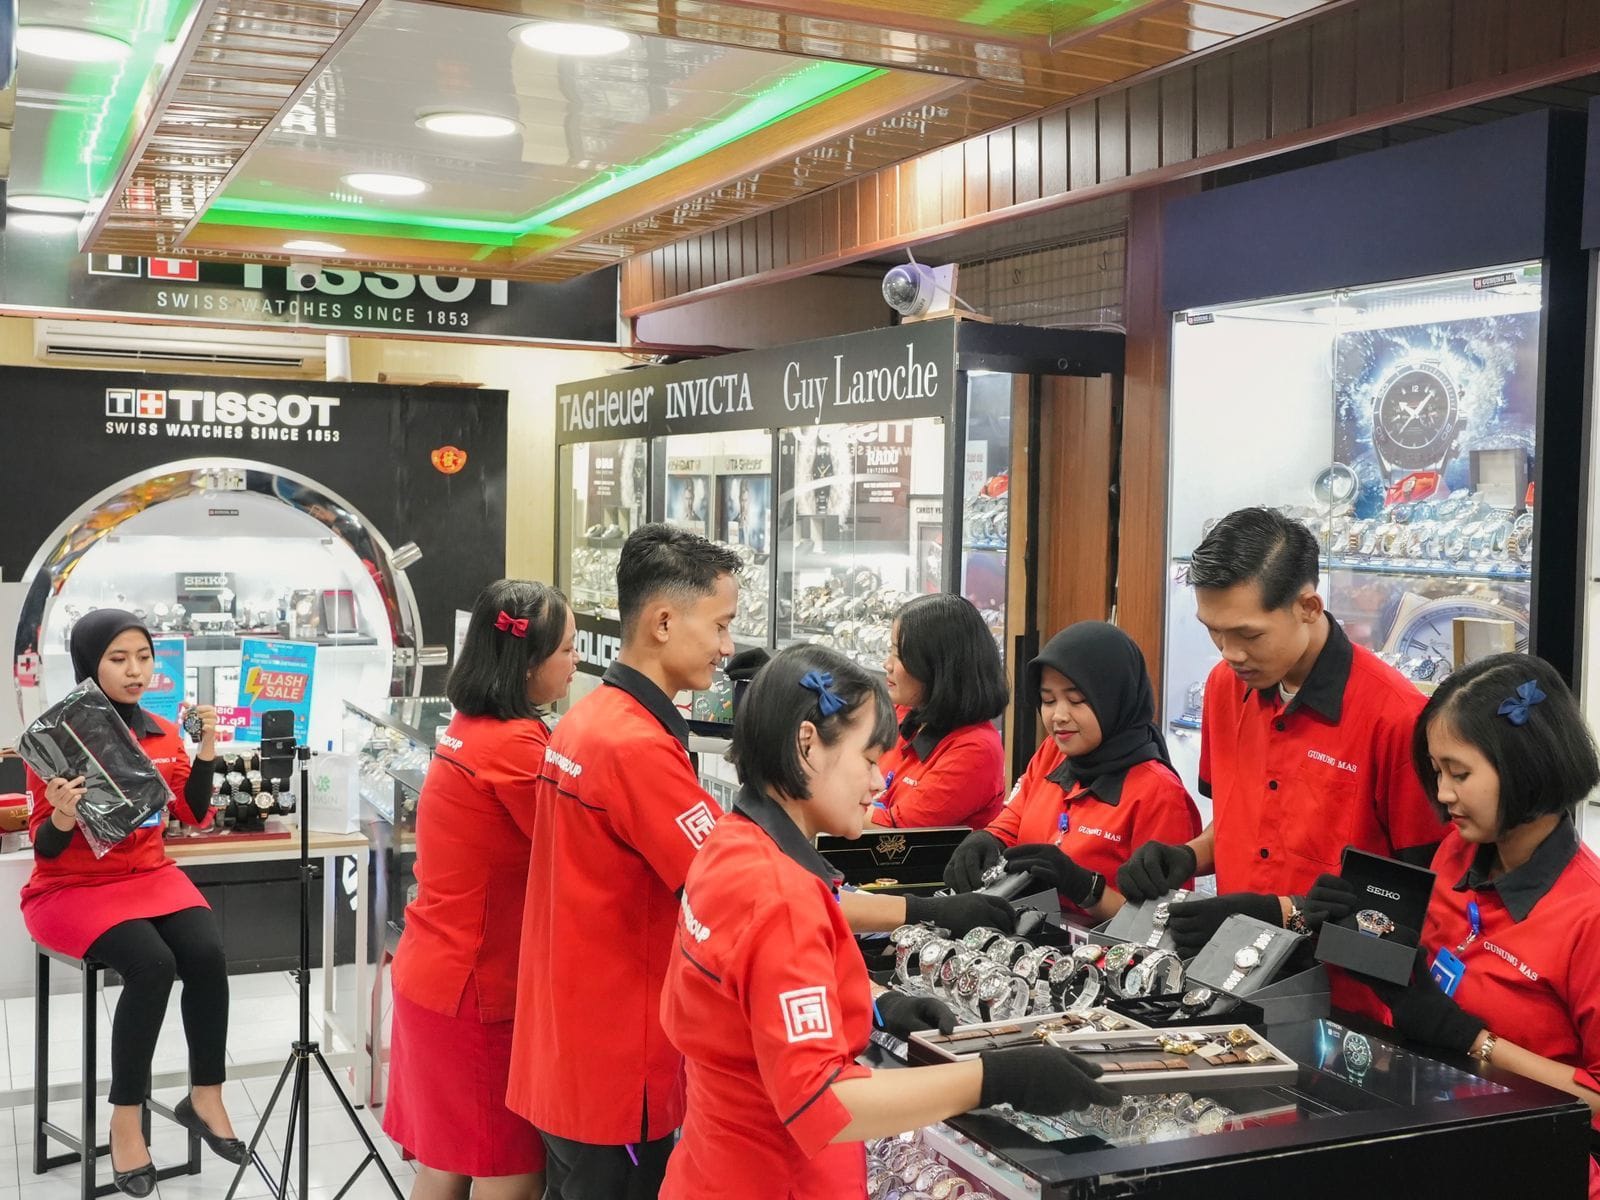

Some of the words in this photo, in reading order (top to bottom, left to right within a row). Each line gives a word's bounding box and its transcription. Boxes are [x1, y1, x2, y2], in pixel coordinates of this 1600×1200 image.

[157, 291, 228, 310] SWISS
[241, 297, 341, 318] WATCHES
[354, 305, 415, 323] SINCE
[427, 310, 469, 327] 1853
[665, 372, 754, 419] INVICTA
[783, 361, 828, 425] Guy
[833, 342, 938, 405] Laroche
[168, 389, 341, 426] TISSOT
[105, 421, 158, 436] SWISS
[166, 423, 243, 439] WATCHES
[251, 426, 299, 441] SINCE
[307, 429, 340, 442] 1853
[184, 575, 229, 586] SEIKO
[573, 629, 621, 668] OLICE
[259, 672, 304, 688] FLASH
[265, 685, 300, 700] SALE
[1307, 749, 1336, 767] GUNUNG
[1337, 760, 1358, 773] MAS
[1103, 832, 1121, 842] MAS
[1366, 884, 1401, 901] SEIKO
[1483, 941, 1518, 967] GUNUNG
[1518, 962, 1538, 981] MAS
